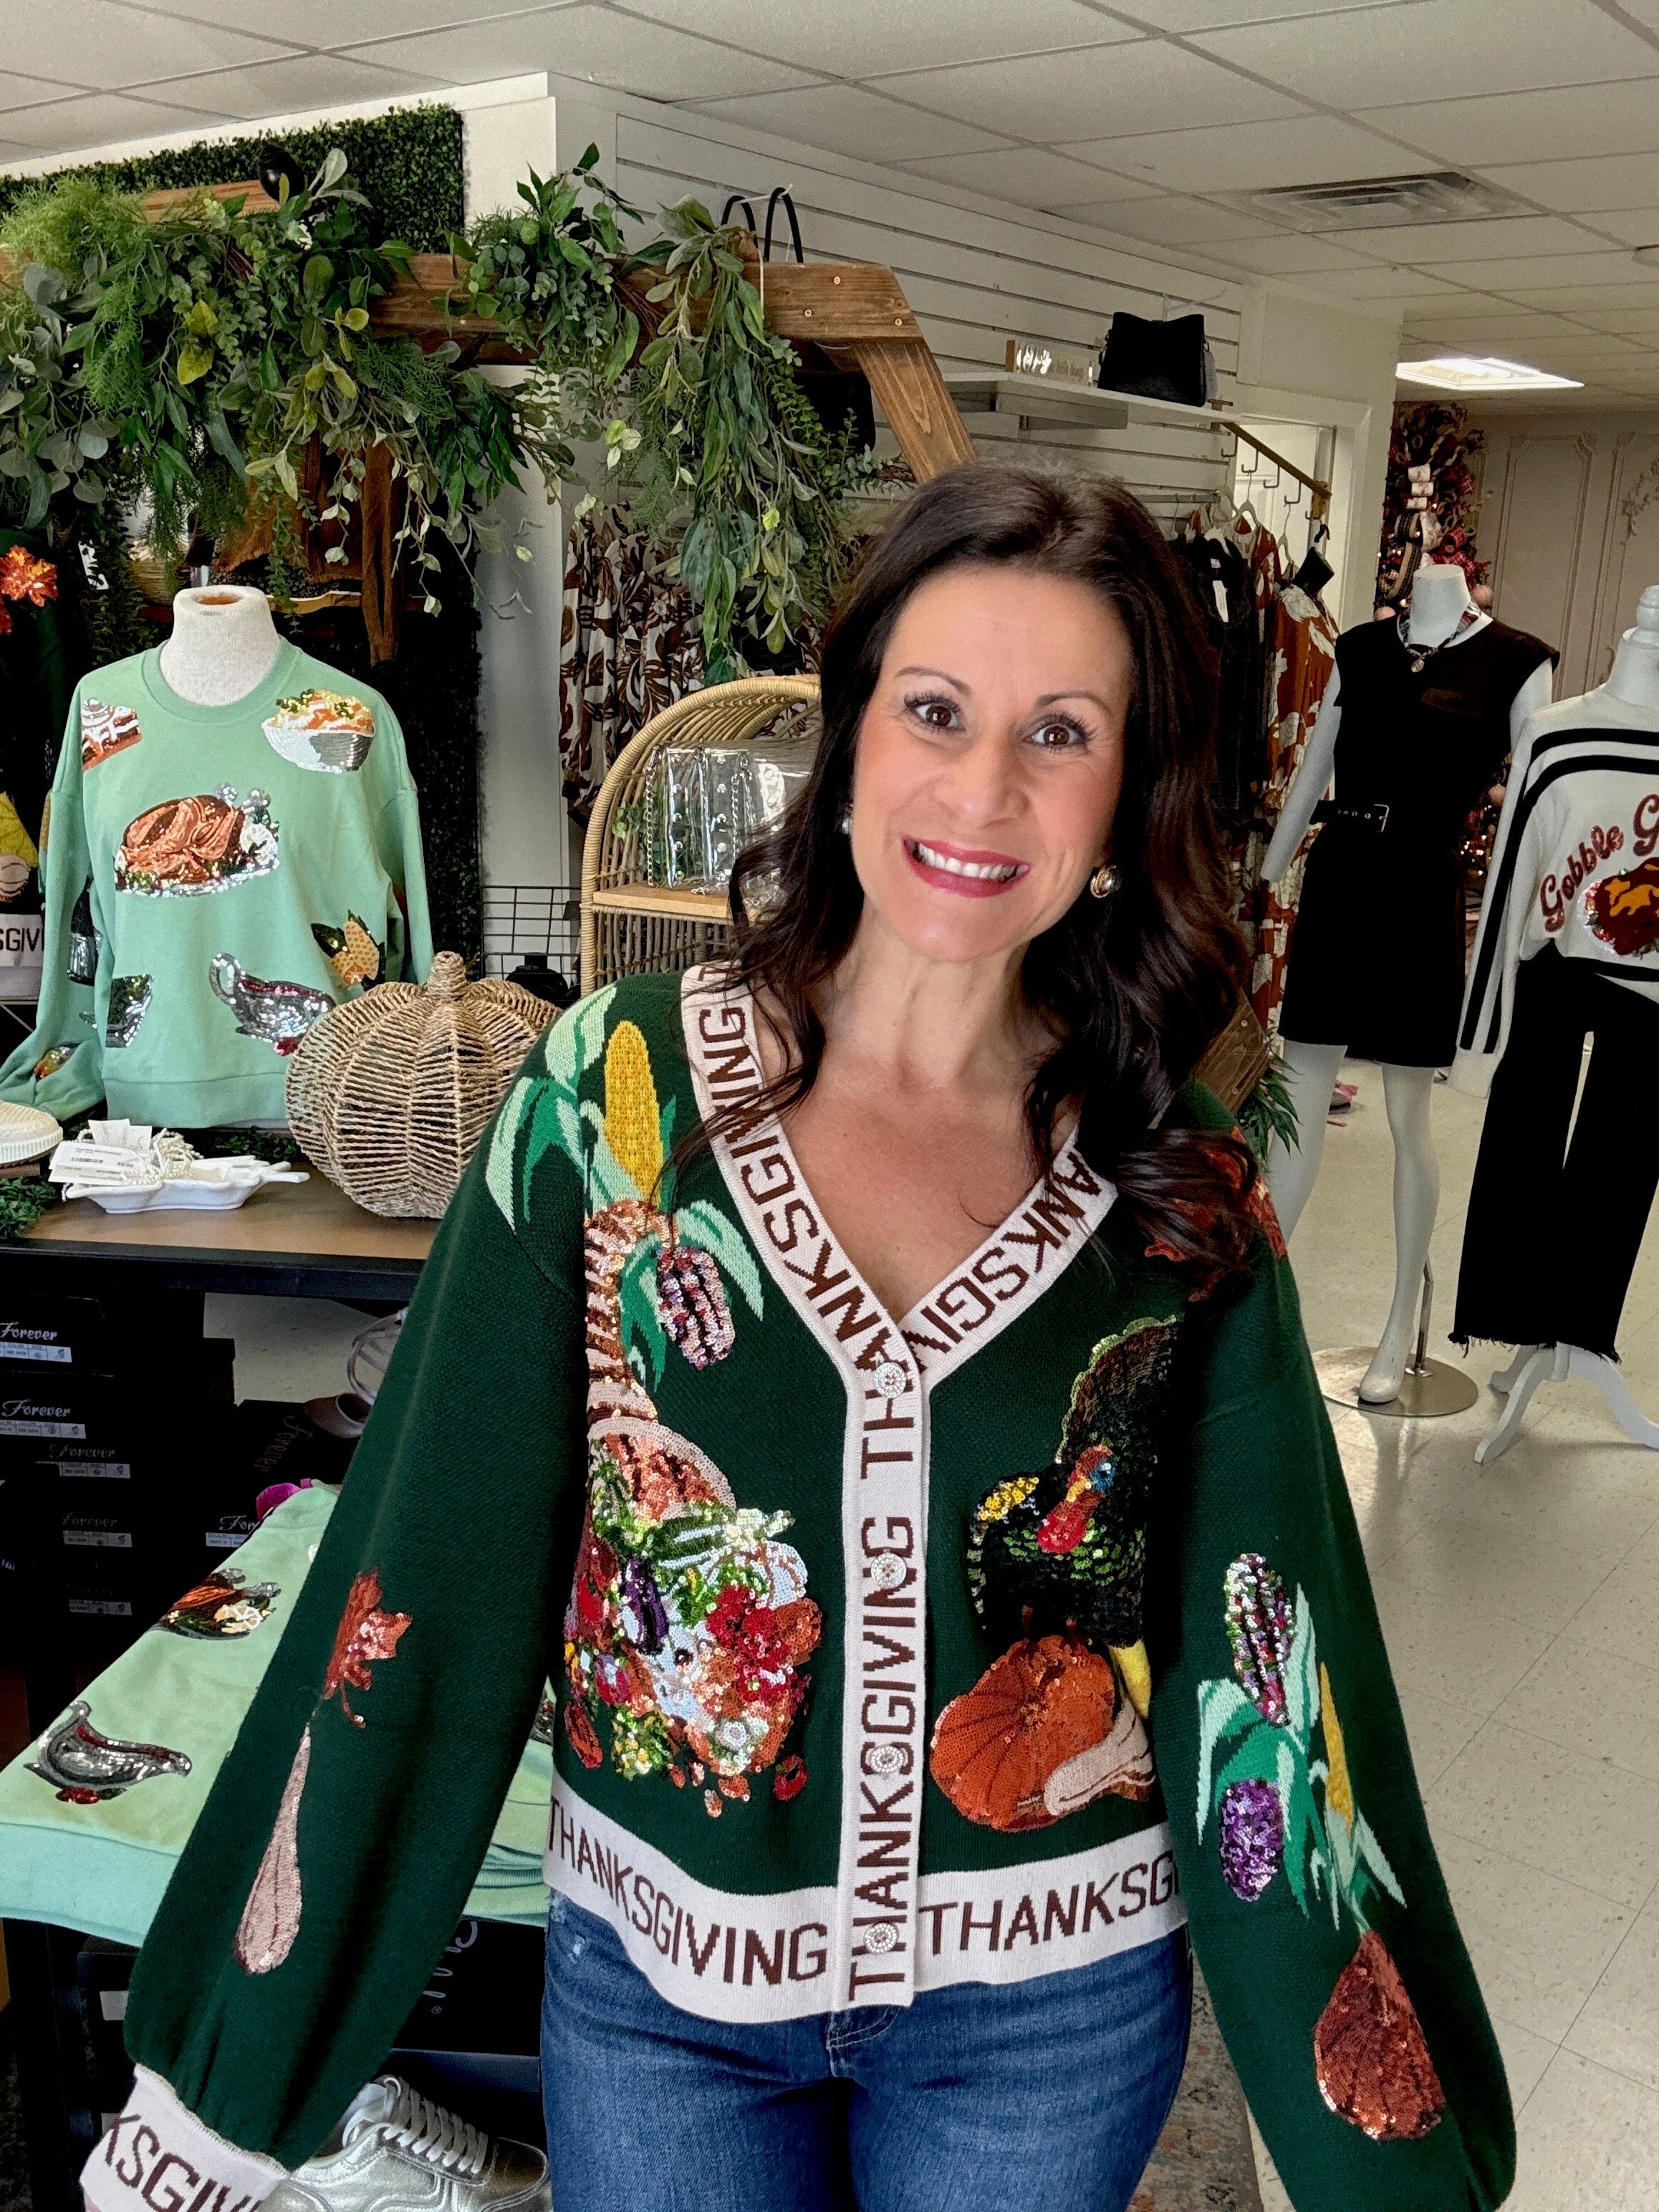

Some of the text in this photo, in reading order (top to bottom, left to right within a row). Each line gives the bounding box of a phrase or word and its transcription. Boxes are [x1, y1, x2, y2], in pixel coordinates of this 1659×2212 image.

[1540, 825, 1624, 933] Gobble
[0, 1322, 57, 1340] Forever
[1, 1399, 71, 1417] Forever
[549, 1795, 827, 1986] THANKSGIVING
